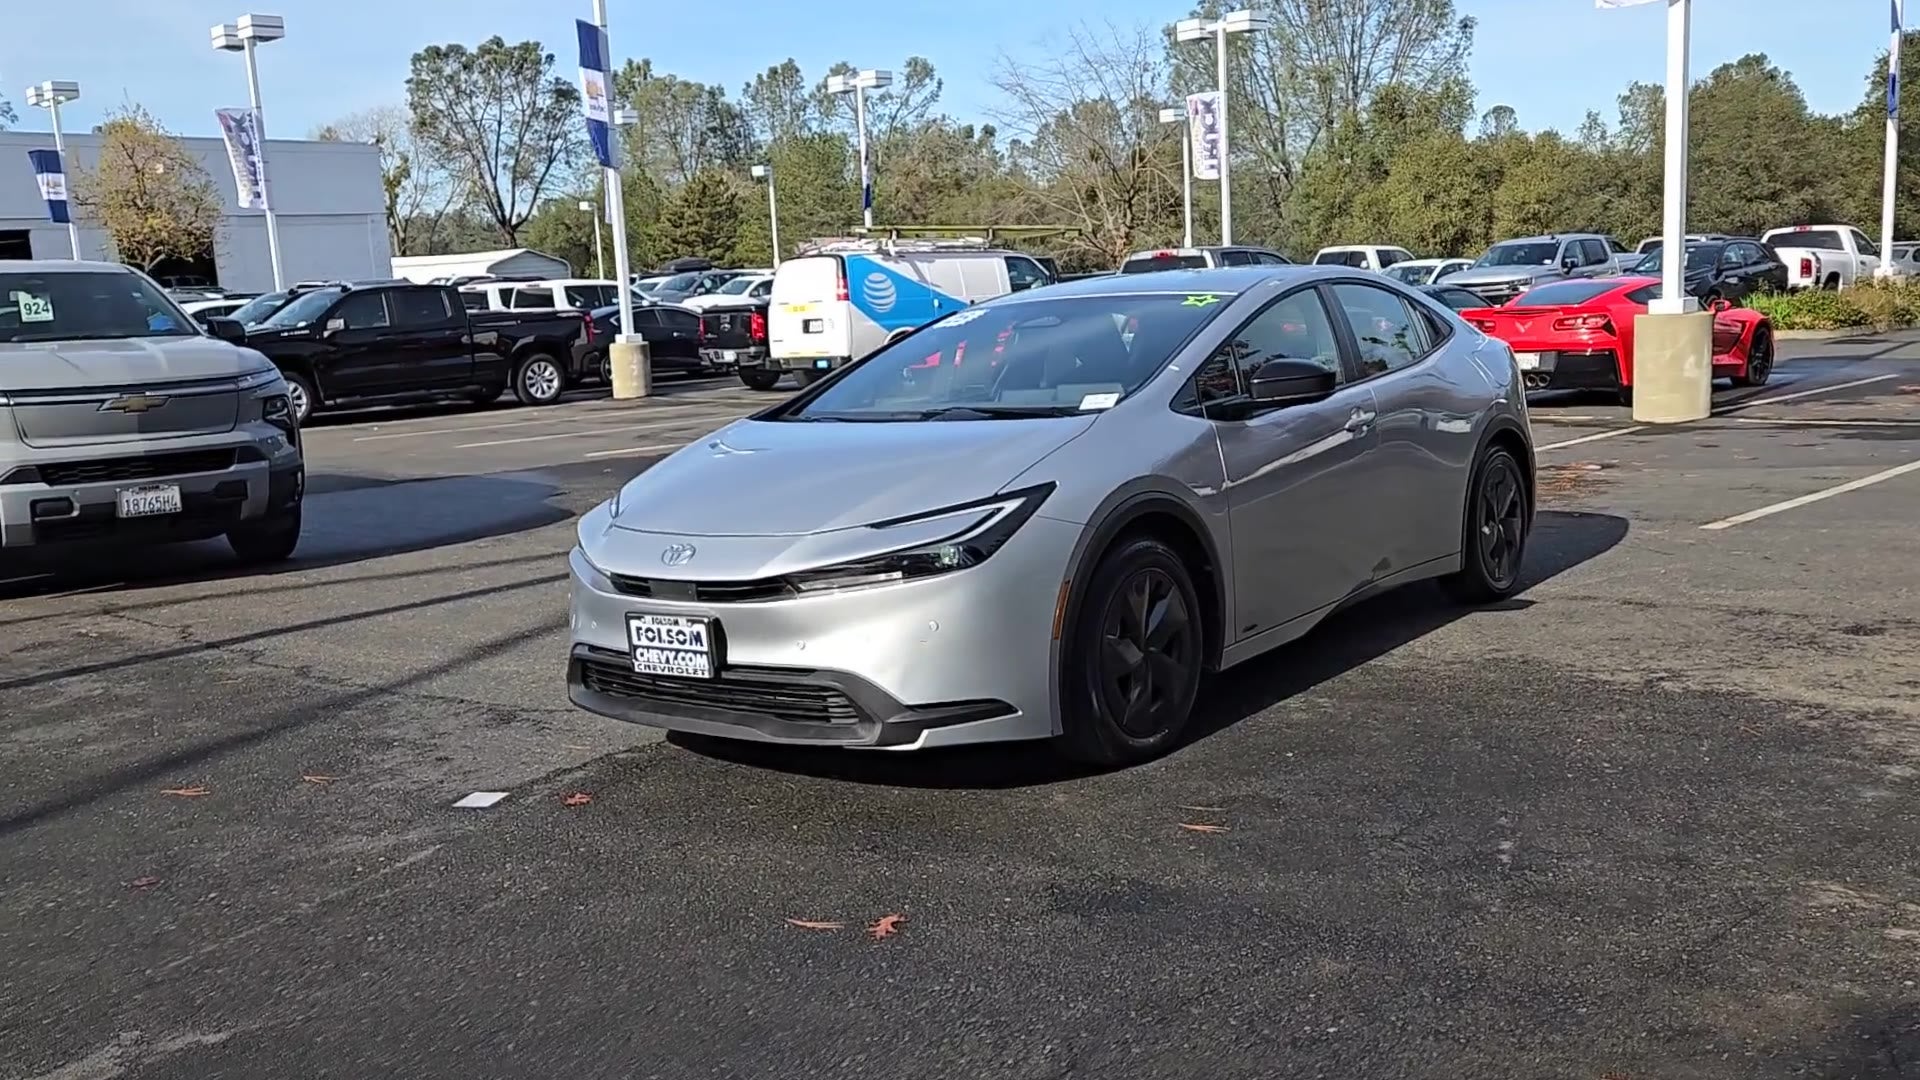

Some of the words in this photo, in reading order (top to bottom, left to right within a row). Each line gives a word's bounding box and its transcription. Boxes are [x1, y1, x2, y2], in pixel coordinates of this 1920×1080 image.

[24, 301, 50, 315] 924
[636, 626, 704, 647] FOLSOM
[635, 647, 709, 669] CHEVY.COM
[637, 663, 706, 676] CHEVROLET
